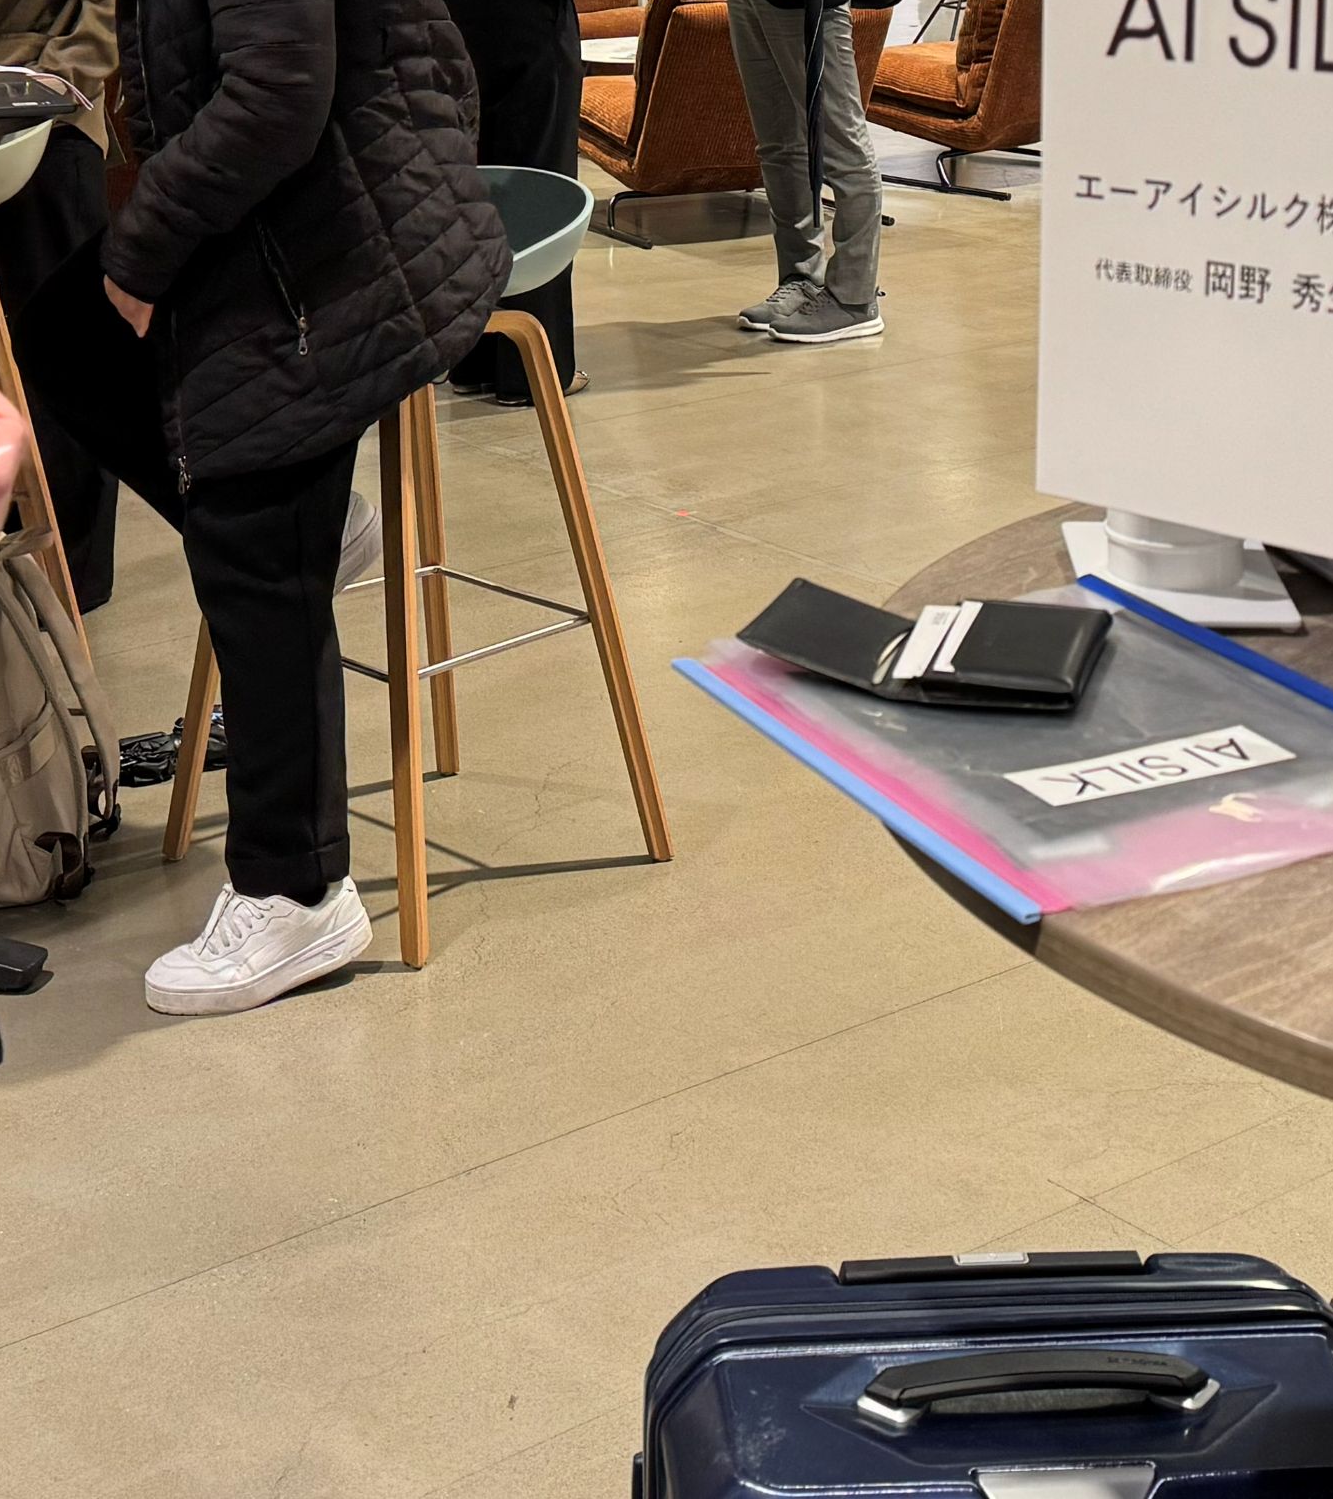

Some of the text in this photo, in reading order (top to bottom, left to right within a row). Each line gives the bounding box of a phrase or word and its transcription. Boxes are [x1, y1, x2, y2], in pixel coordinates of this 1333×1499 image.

[1095, 257, 1194, 293] 代表取締役
[1204, 260, 1271, 304] 岡野
[1040, 737, 1251, 796] AI SILK
